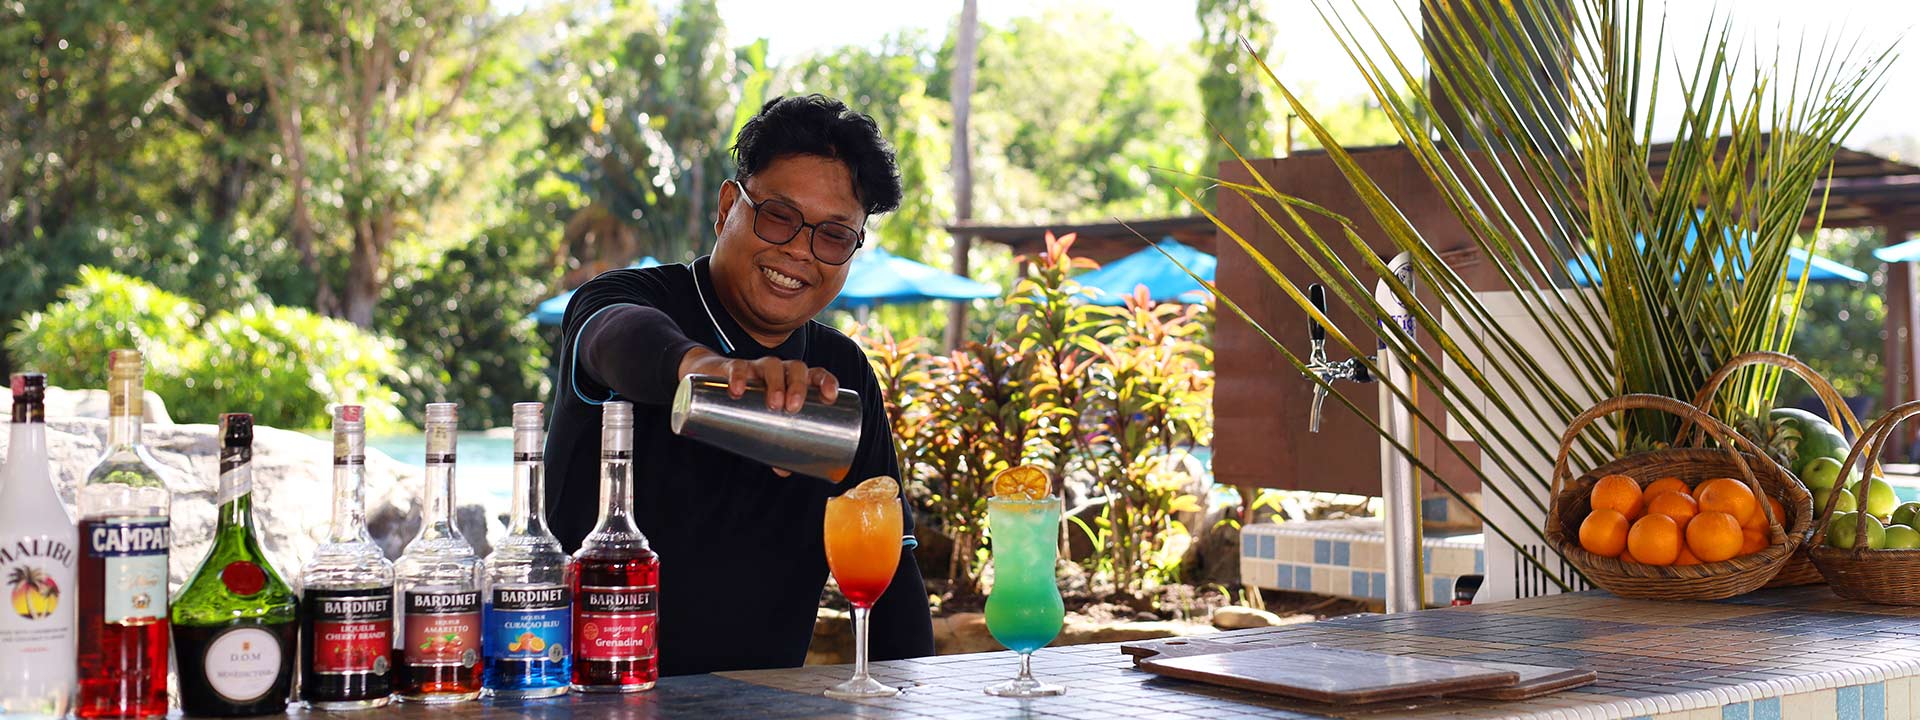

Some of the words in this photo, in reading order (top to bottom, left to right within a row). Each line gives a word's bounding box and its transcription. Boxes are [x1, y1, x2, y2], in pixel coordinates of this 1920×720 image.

[414, 593, 477, 607] BARDINET
[501, 589, 563, 603] BARDINET
[589, 593, 650, 606] BARDINET
[324, 600, 387, 614] BARDINET
[340, 624, 376, 633] LIQUEUR
[424, 625, 469, 633] AMARETTO
[595, 637, 644, 647] Grenadine
